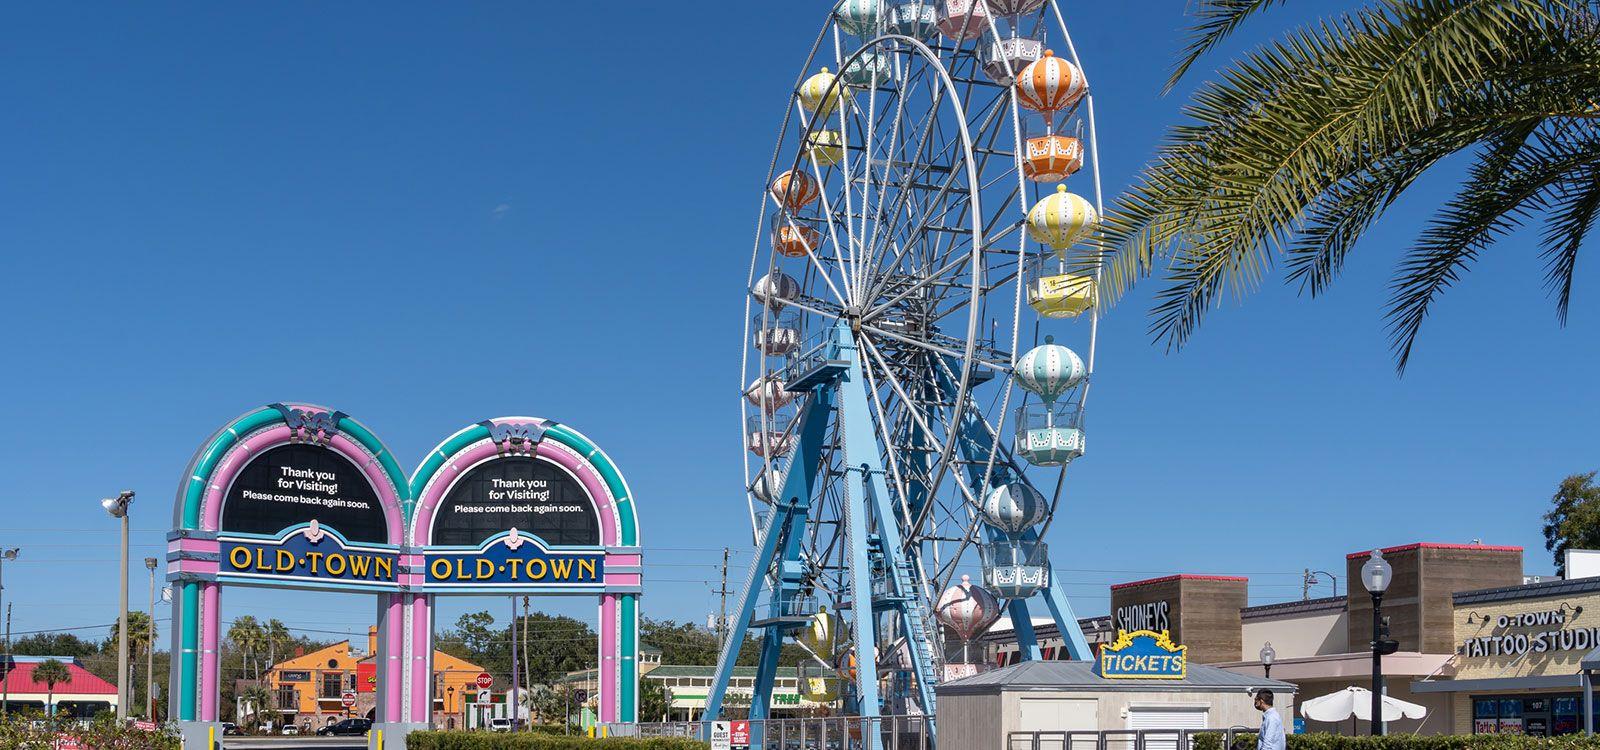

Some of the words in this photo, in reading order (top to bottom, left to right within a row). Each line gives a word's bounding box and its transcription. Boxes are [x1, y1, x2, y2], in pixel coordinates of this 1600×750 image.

[1037, 140, 1043, 148] 17
[281, 466, 315, 478] Thank
[315, 471, 335, 481] you
[277, 478, 294, 489] for
[296, 480, 338, 495] Visiting!
[492, 478, 525, 488] Thank
[526, 480, 547, 489] you
[242, 490, 273, 501] Please
[273, 494, 299, 503] come
[300, 495, 322, 505] back
[322, 498, 346, 508] again
[346, 500, 370, 509] soon.
[488, 490, 505, 500] for
[506, 490, 550, 501] Visiting!
[454, 504, 484, 513] Please
[484, 505, 510, 513] come
[511, 504, 532, 513] back
[533, 505, 558, 514] again
[558, 505, 584, 513] soon.
[1117, 600, 1168, 632] SHONEY'S
[1497, 610, 1564, 628] O-TOWN
[1464, 634, 1527, 658] TATTOO
[1104, 655, 1183, 671] TICKETS
[773, 693, 801, 705] TREE
